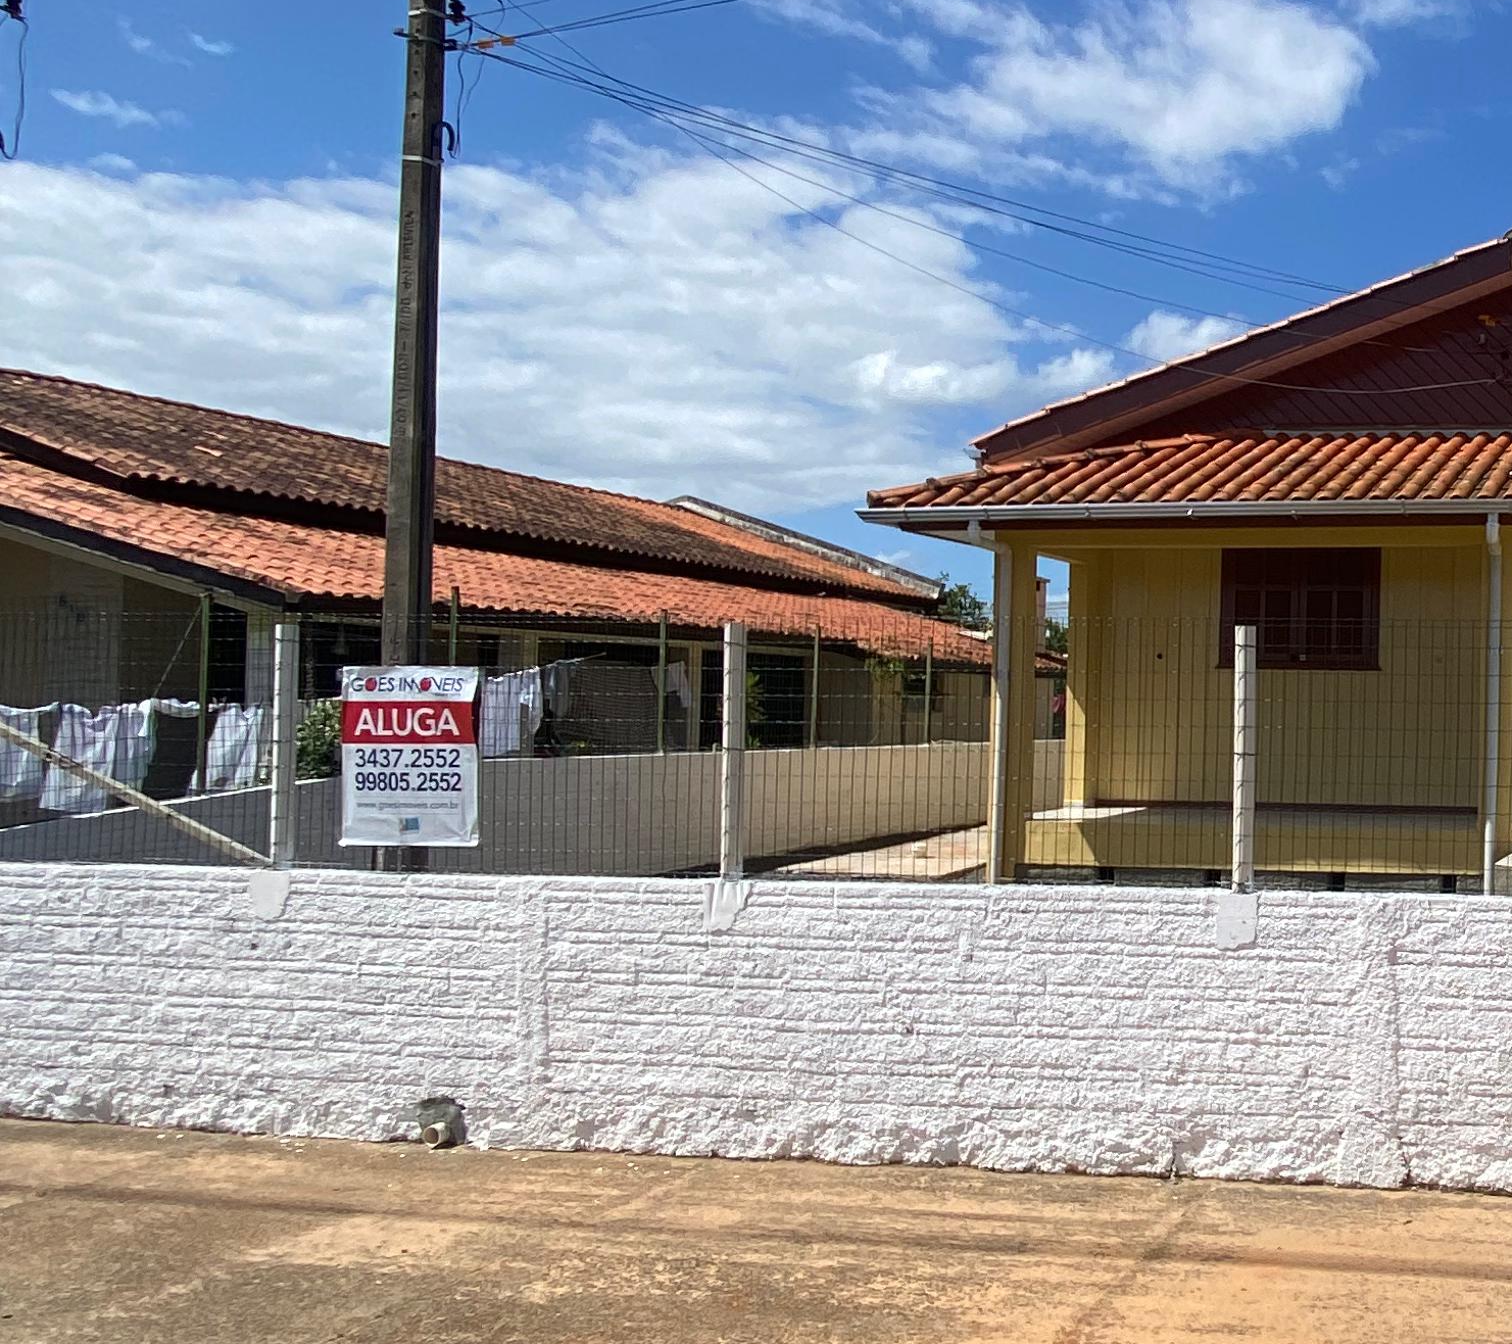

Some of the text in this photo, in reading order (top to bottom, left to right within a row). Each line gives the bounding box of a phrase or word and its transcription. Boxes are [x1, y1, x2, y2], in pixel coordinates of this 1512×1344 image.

[350, 677, 395, 692] GOES
[353, 708, 460, 736] ALUGA
[355, 748, 461, 768] 3437.2552
[355, 772, 462, 792] 99805.2552
